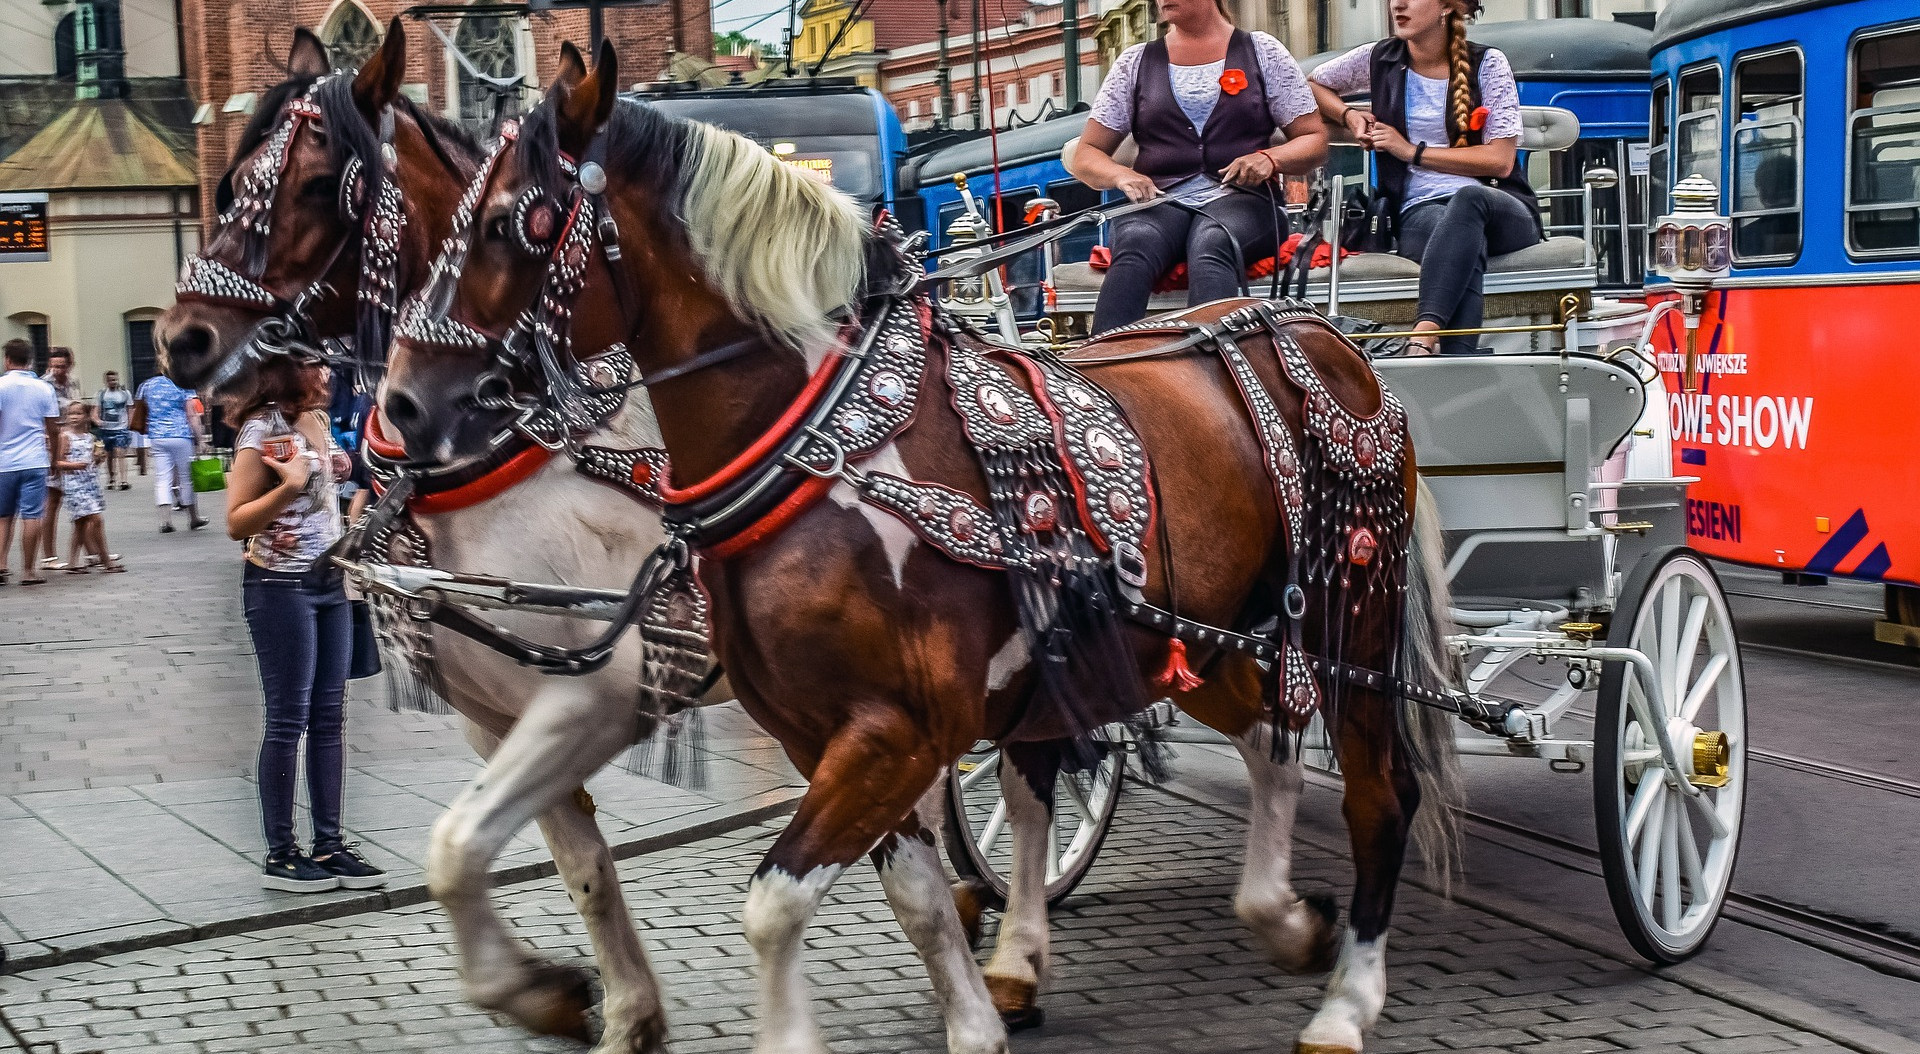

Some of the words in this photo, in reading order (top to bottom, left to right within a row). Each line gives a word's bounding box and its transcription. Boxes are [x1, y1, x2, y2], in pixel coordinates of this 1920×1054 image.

[1695, 353, 1748, 378] AJWIĘKSZE
[1667, 392, 1712, 444] OWE
[1717, 395, 1813, 449] SHOW
